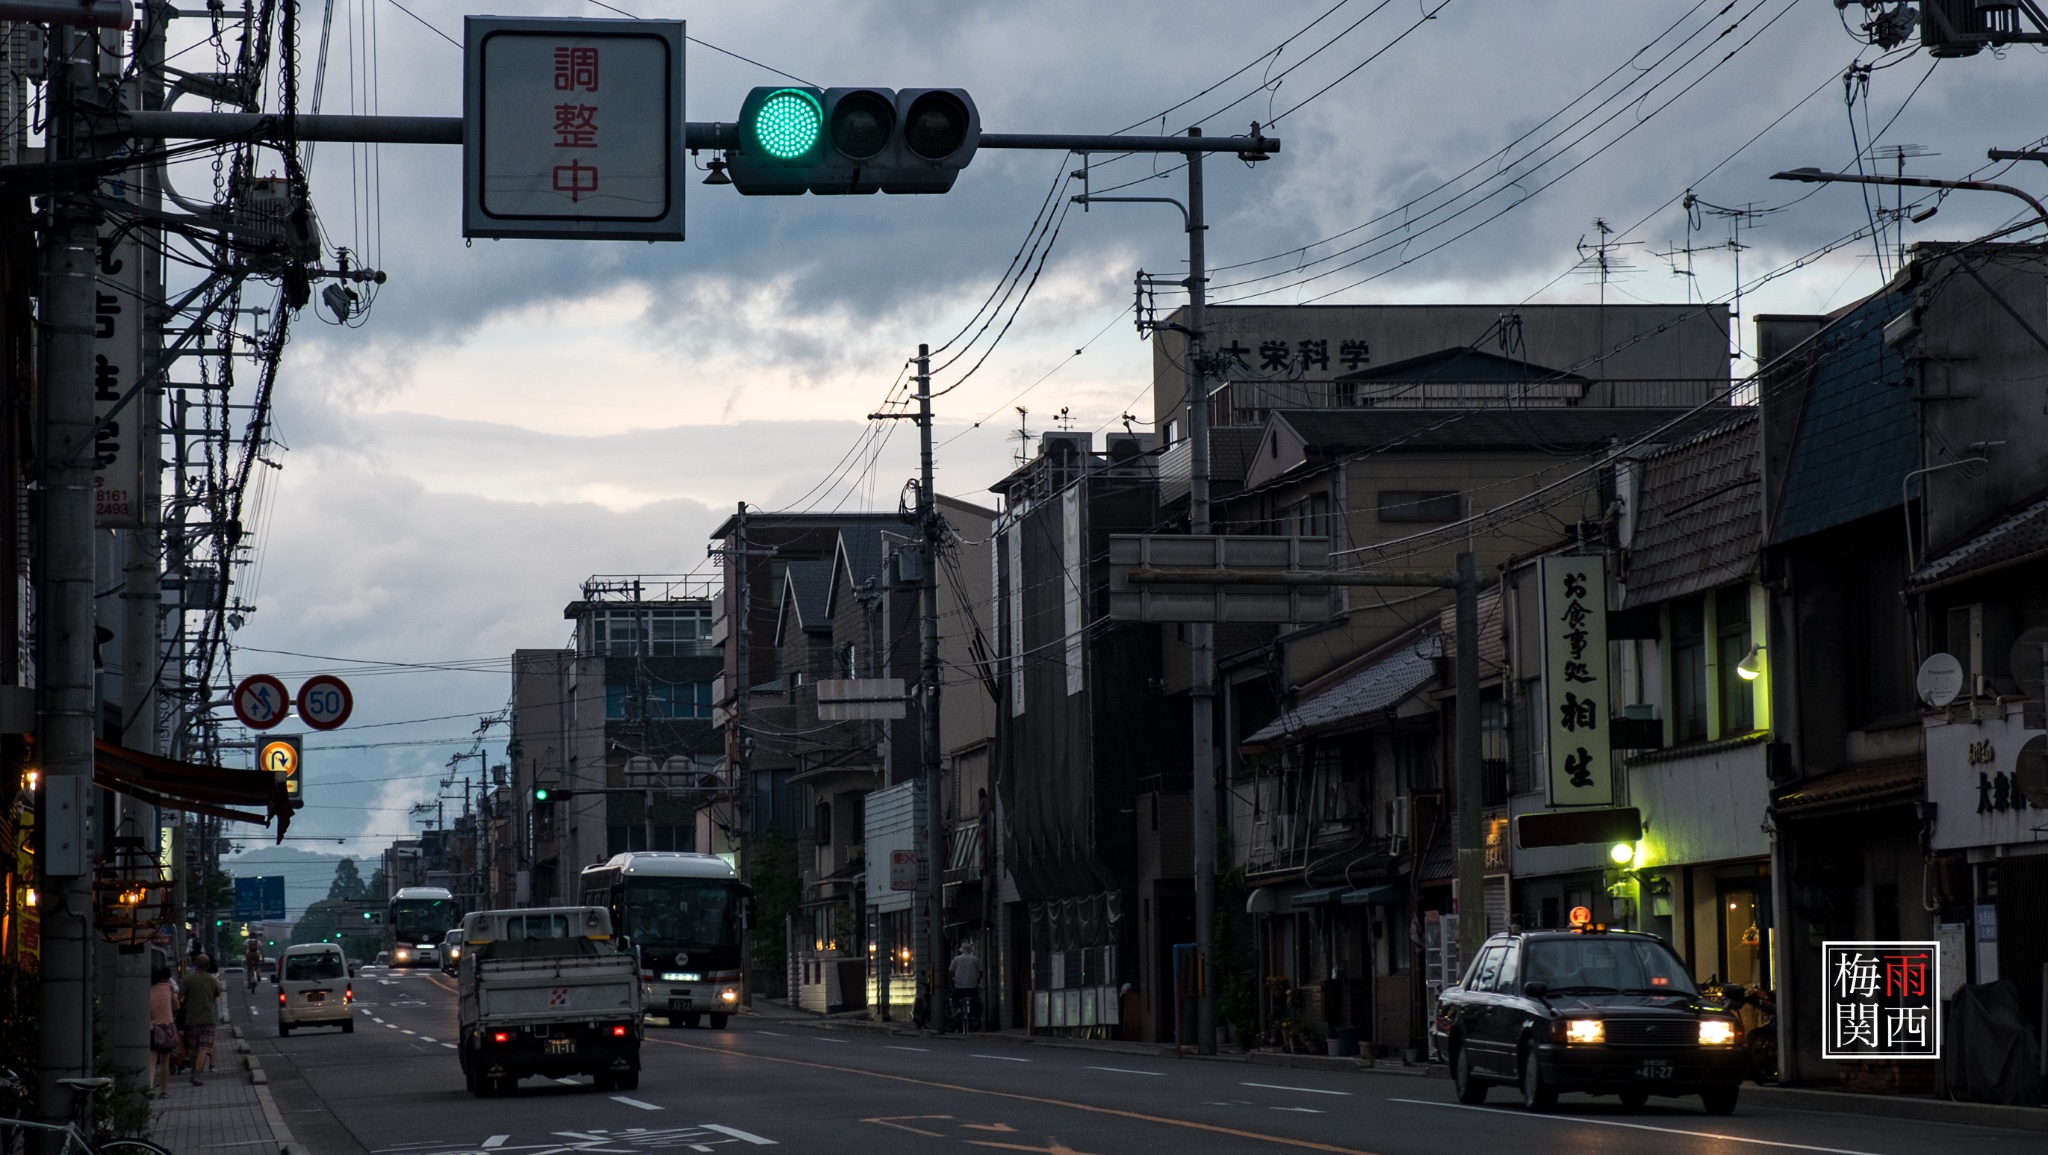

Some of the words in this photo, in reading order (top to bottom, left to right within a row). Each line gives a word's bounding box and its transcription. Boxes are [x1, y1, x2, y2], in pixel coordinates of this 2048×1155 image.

[552, 46, 599, 204] 調整中
[1218, 339, 1370, 371] 大栄科学
[96, 490, 127, 502] 8161
[96, 503, 129, 515] 2493
[1561, 572, 1596, 683] お食事処
[309, 690, 340, 715] 50
[1560, 692, 1597, 788] 相生
[1642, 1066, 1674, 1078] 41-27
